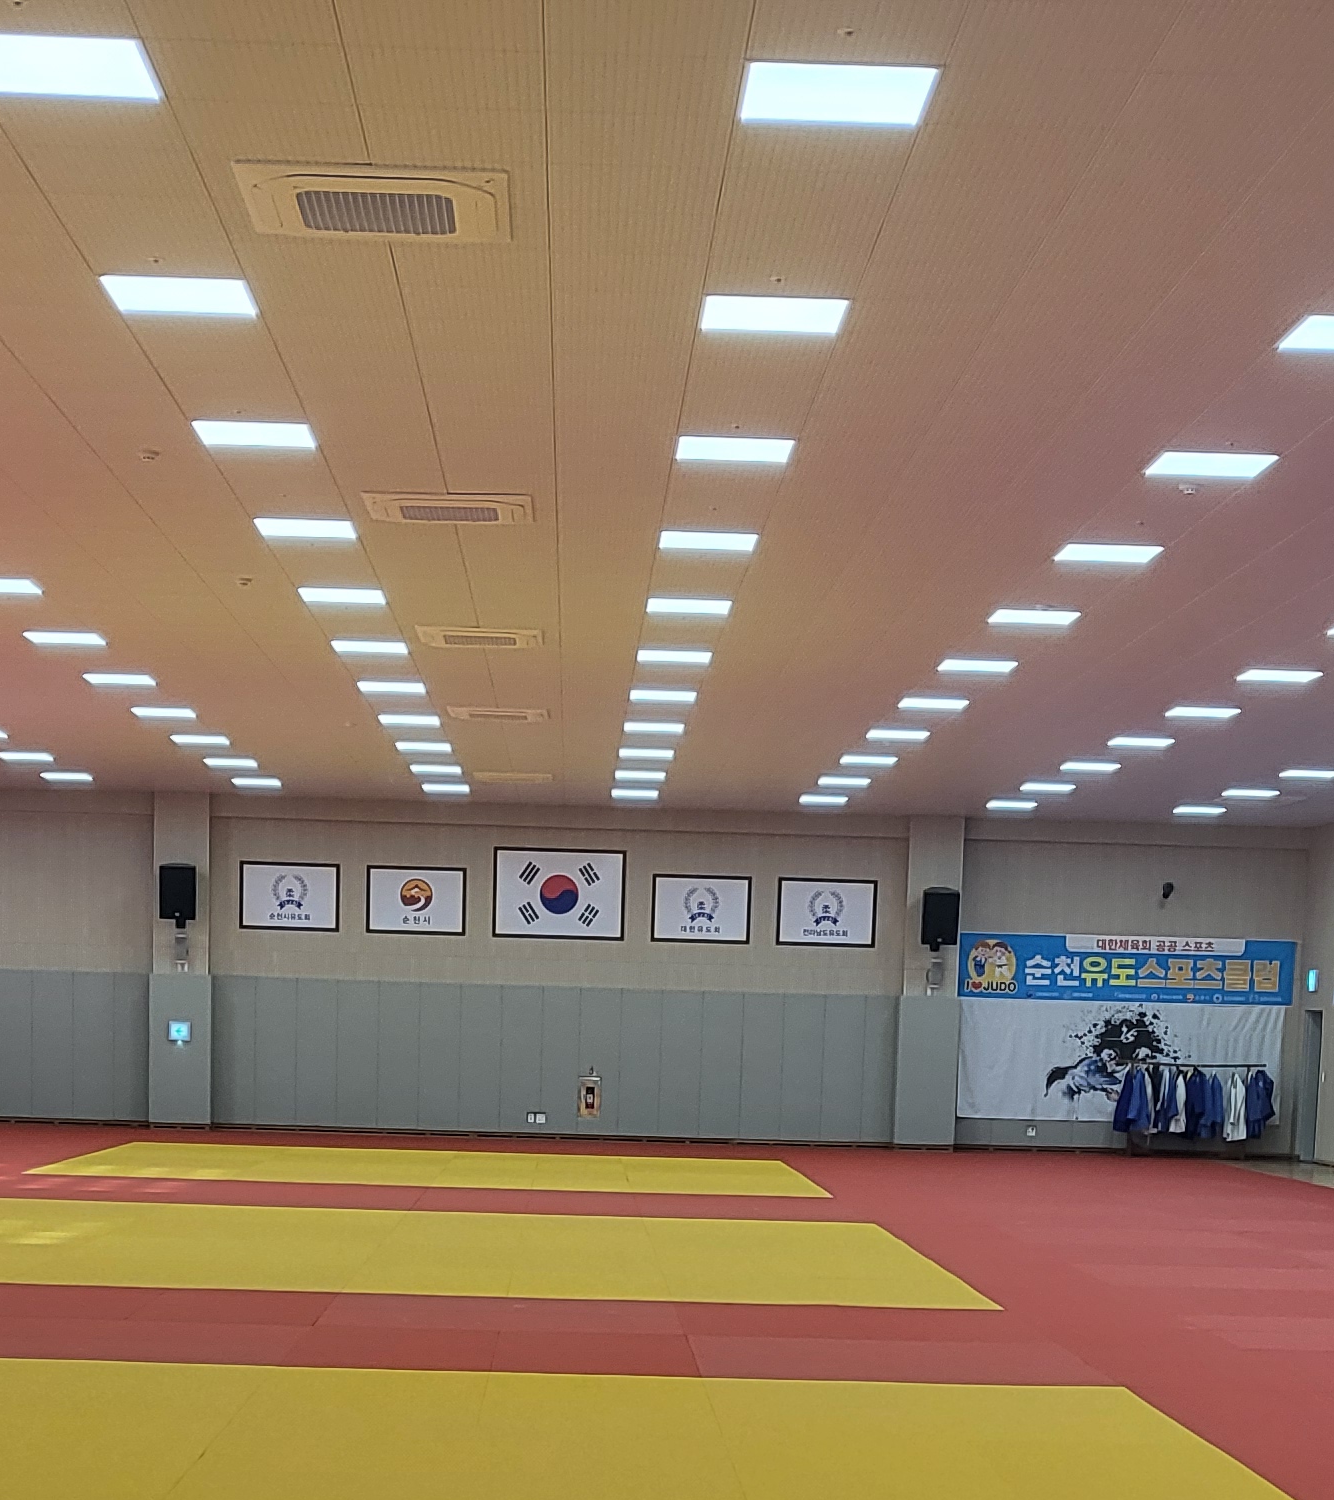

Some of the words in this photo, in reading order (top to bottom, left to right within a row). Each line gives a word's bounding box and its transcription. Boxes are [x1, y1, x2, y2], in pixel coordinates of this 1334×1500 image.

[1096, 938, 1152, 952] 대한체육회
[1156, 940, 1178, 953] 공공
[1180, 941, 1215, 953] 스포츠
[982, 981, 1017, 992] JUDO
